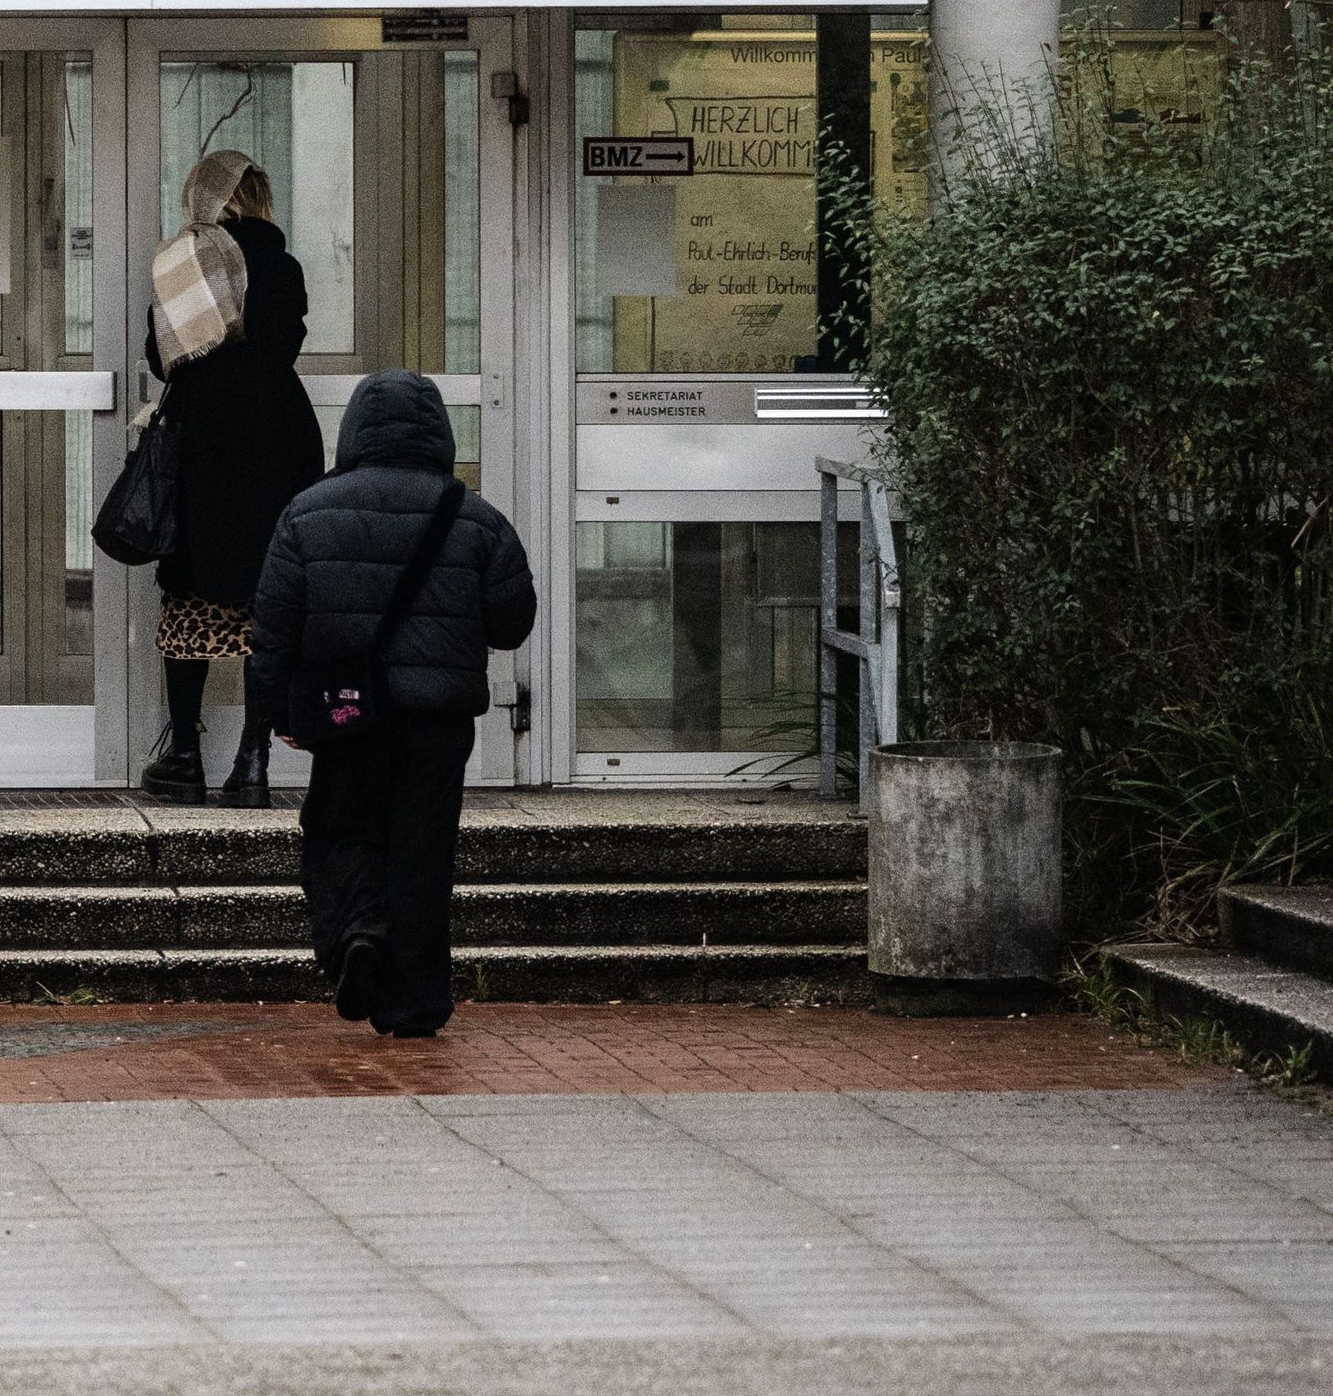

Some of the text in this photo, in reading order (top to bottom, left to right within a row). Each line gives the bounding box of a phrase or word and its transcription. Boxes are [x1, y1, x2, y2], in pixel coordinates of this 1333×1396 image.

[691, 106, 799, 134] HERZLICH
[590, 145, 643, 168] BMZ
[693, 139, 816, 168] WILLKOMM
[690, 214, 714, 227] am
[688, 275, 710, 295] der
[718, 275, 758, 295] Stadt
[627, 391, 703, 401] SEKRETARIAT
[627, 407, 706, 416] HAUSMEISTER
